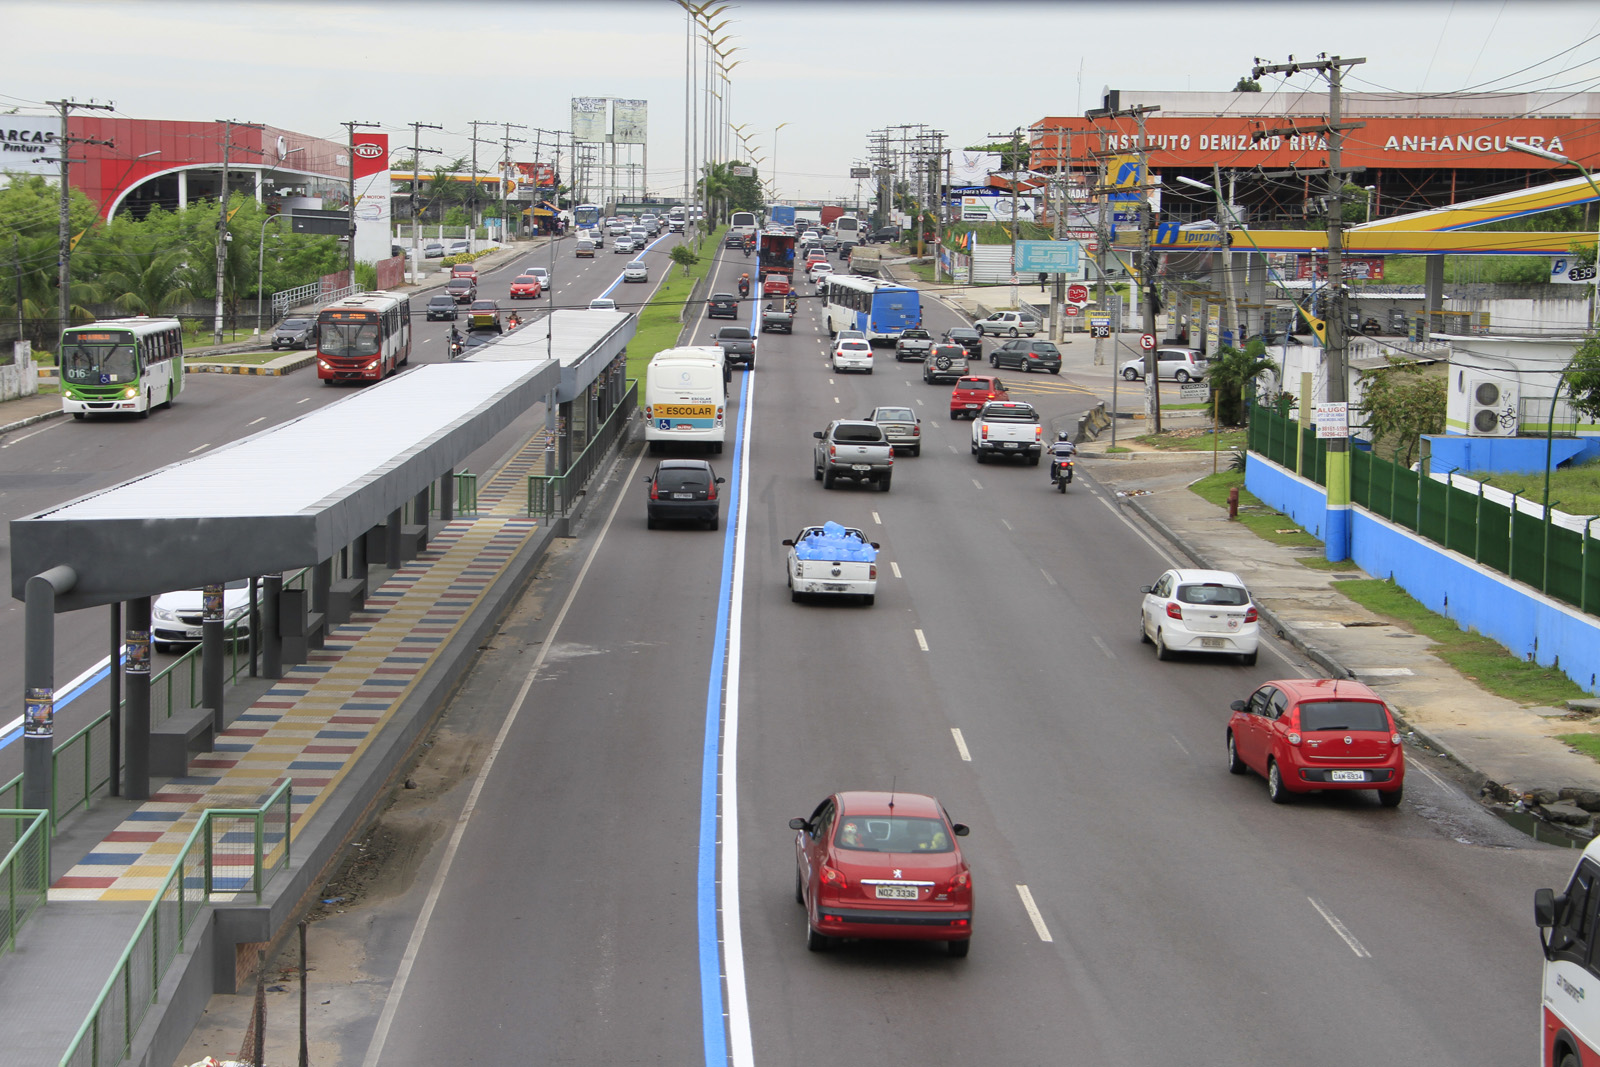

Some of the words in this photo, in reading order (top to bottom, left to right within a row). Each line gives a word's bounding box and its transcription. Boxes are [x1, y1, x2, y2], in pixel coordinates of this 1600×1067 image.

[3, 143, 45, 153] Pintura
[1199, 134, 1281, 151] DENIZARD
[1289, 135, 1343, 151] RIVA
[1384, 135, 1564, 152] ANHANGUERA
[68, 368, 86, 379] 016
[666, 407, 712, 415] ESCOLAR
